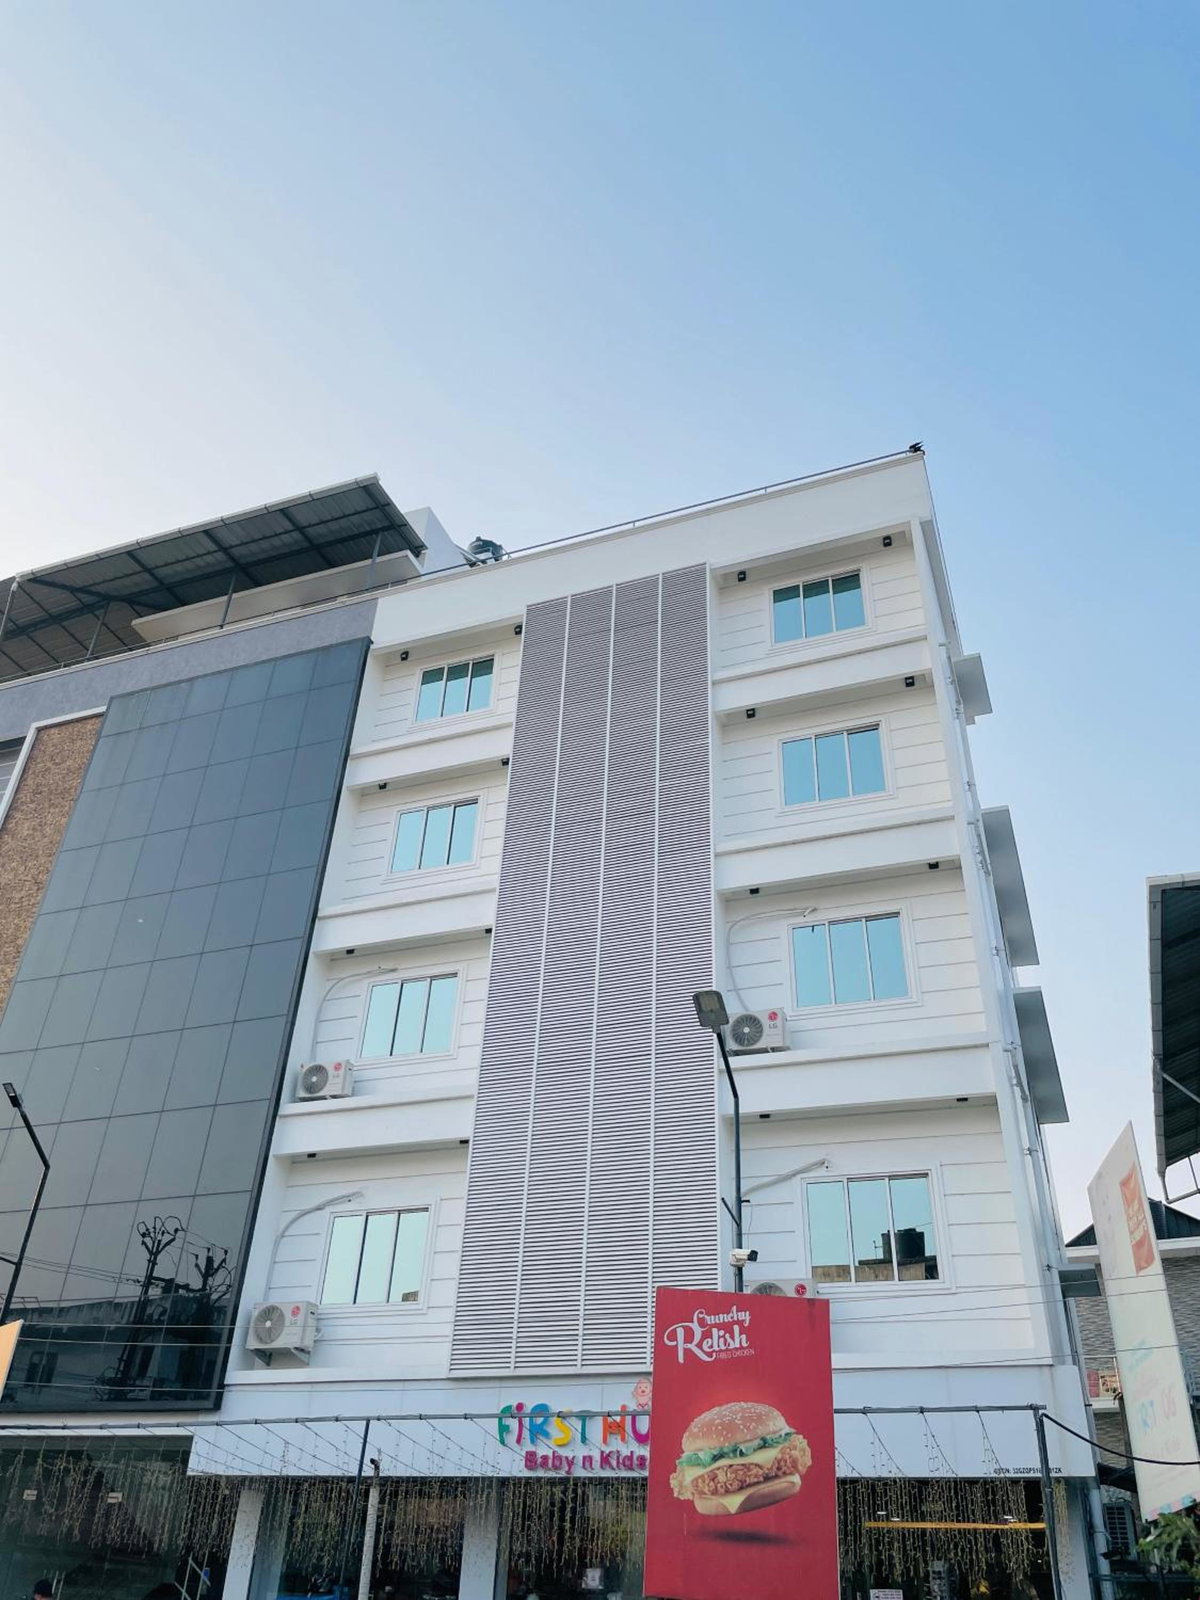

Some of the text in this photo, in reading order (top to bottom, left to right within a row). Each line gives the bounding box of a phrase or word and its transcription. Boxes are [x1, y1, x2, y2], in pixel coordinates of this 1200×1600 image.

[693, 1304, 751, 1331] Crunchy
[664, 1321, 750, 1364] Relish
[524, 1449, 648, 1475] Baby n Kids
